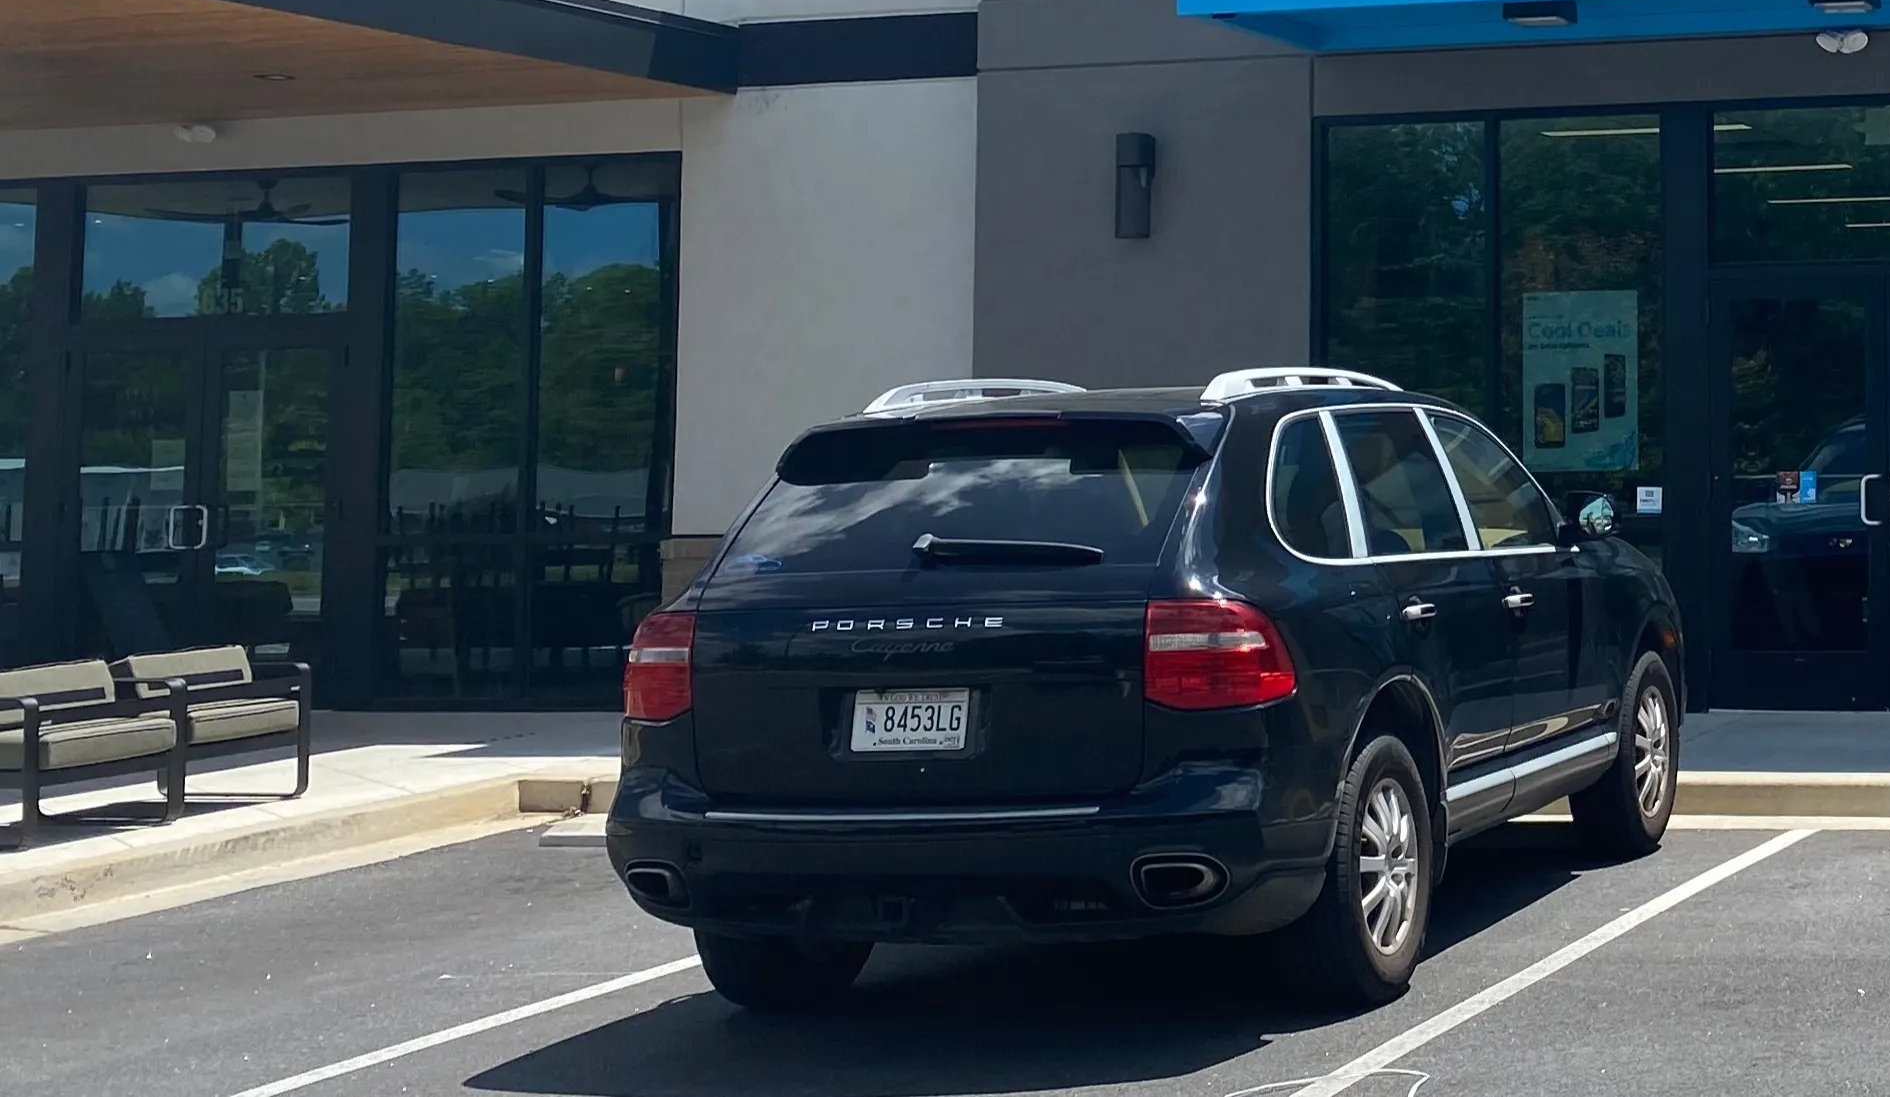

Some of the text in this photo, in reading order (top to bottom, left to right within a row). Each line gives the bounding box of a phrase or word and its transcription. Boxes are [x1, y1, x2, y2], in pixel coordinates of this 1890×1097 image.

[1529, 320, 1632, 339] Cool Deals
[811, 616, 1004, 632] PORSCHE
[850, 639, 955, 662] Cayenne
[884, 704, 962, 732] 8453LG
[878, 737, 901, 745] South
[902, 736, 938, 745] Carolina
